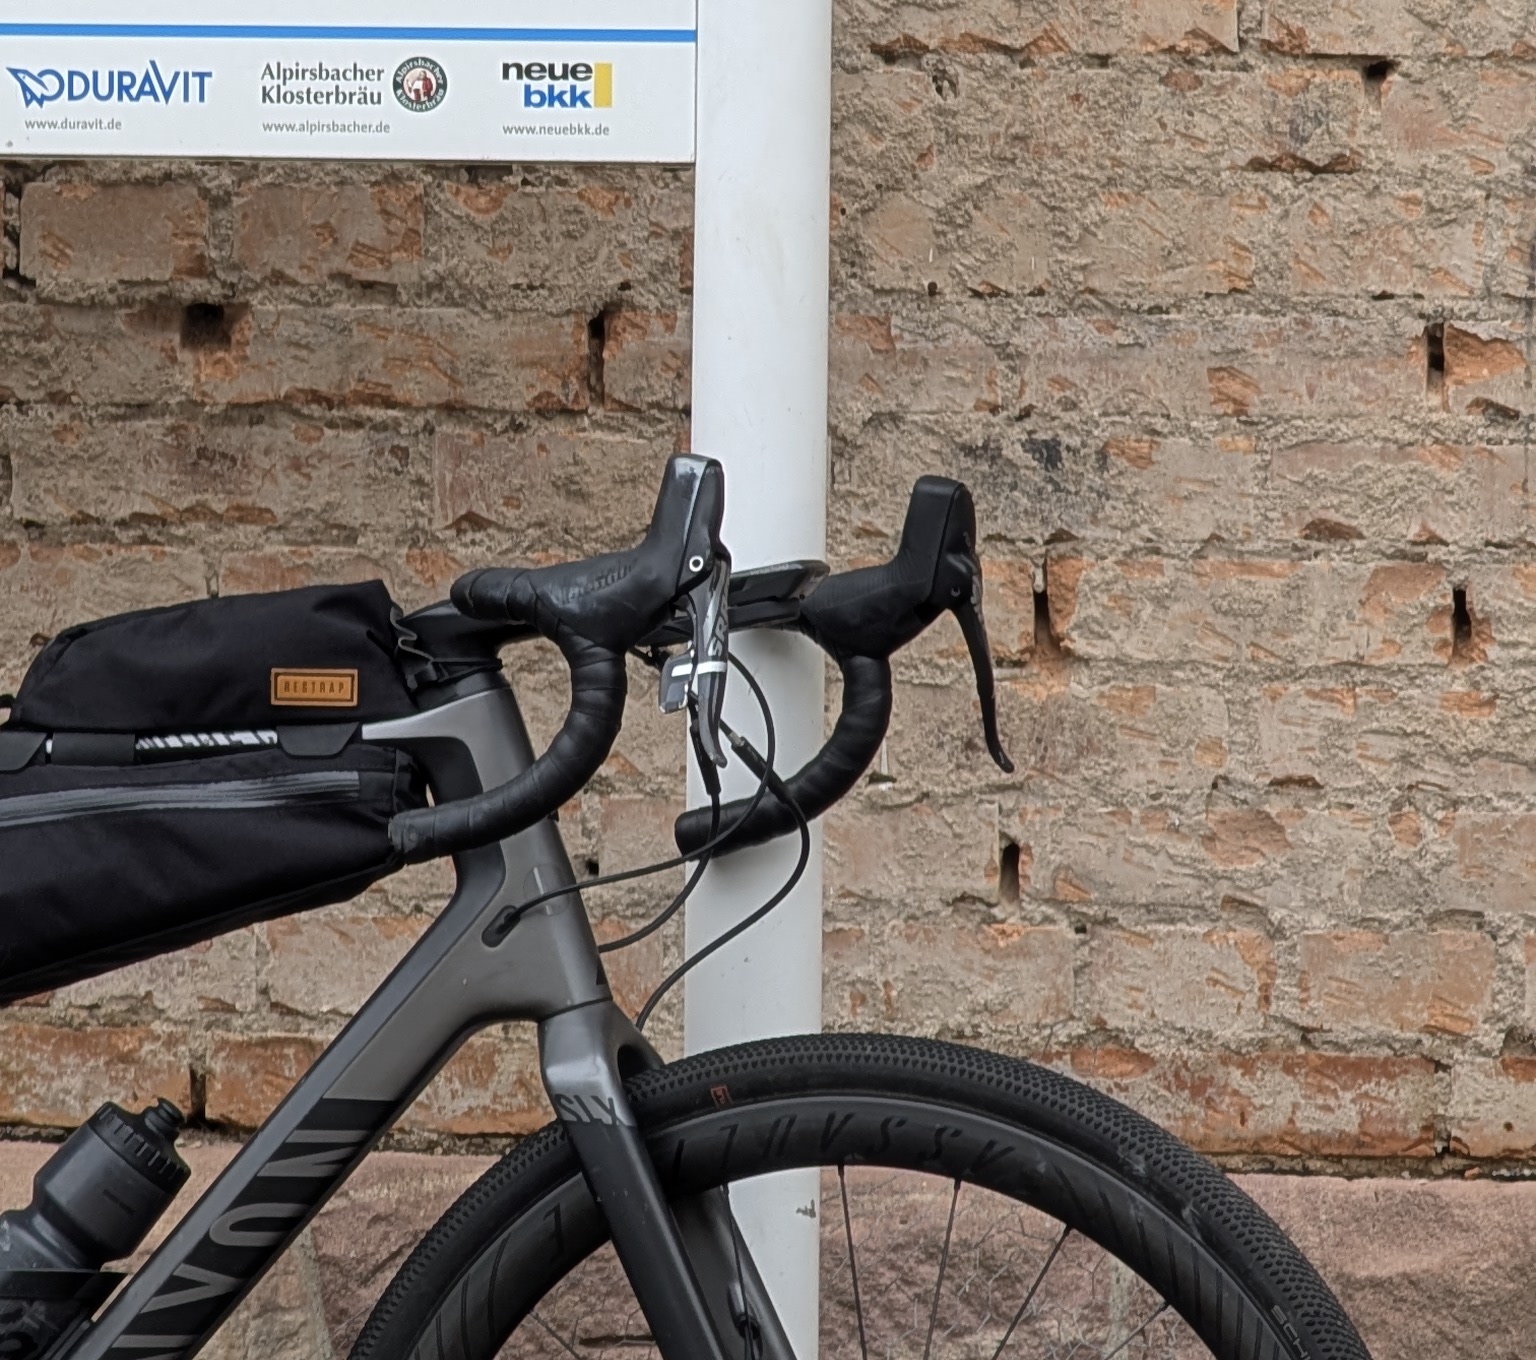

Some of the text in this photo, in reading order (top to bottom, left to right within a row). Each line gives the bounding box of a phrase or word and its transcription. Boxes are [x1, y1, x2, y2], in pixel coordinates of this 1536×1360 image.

[261, 62, 384, 86] Alpirsbacher
[503, 63, 593, 81] neue
[68, 60, 213, 105] DURAVIT
[262, 84, 381, 105] Klosterbräu
[524, 84, 591, 108] bkk
[25, 118, 121, 130] www.duravit.de
[263, 120, 390, 135] www.alpirsbacher.de
[503, 123, 609, 135] www.neuebkk.de
[284, 681, 344, 693] RESTRAP
